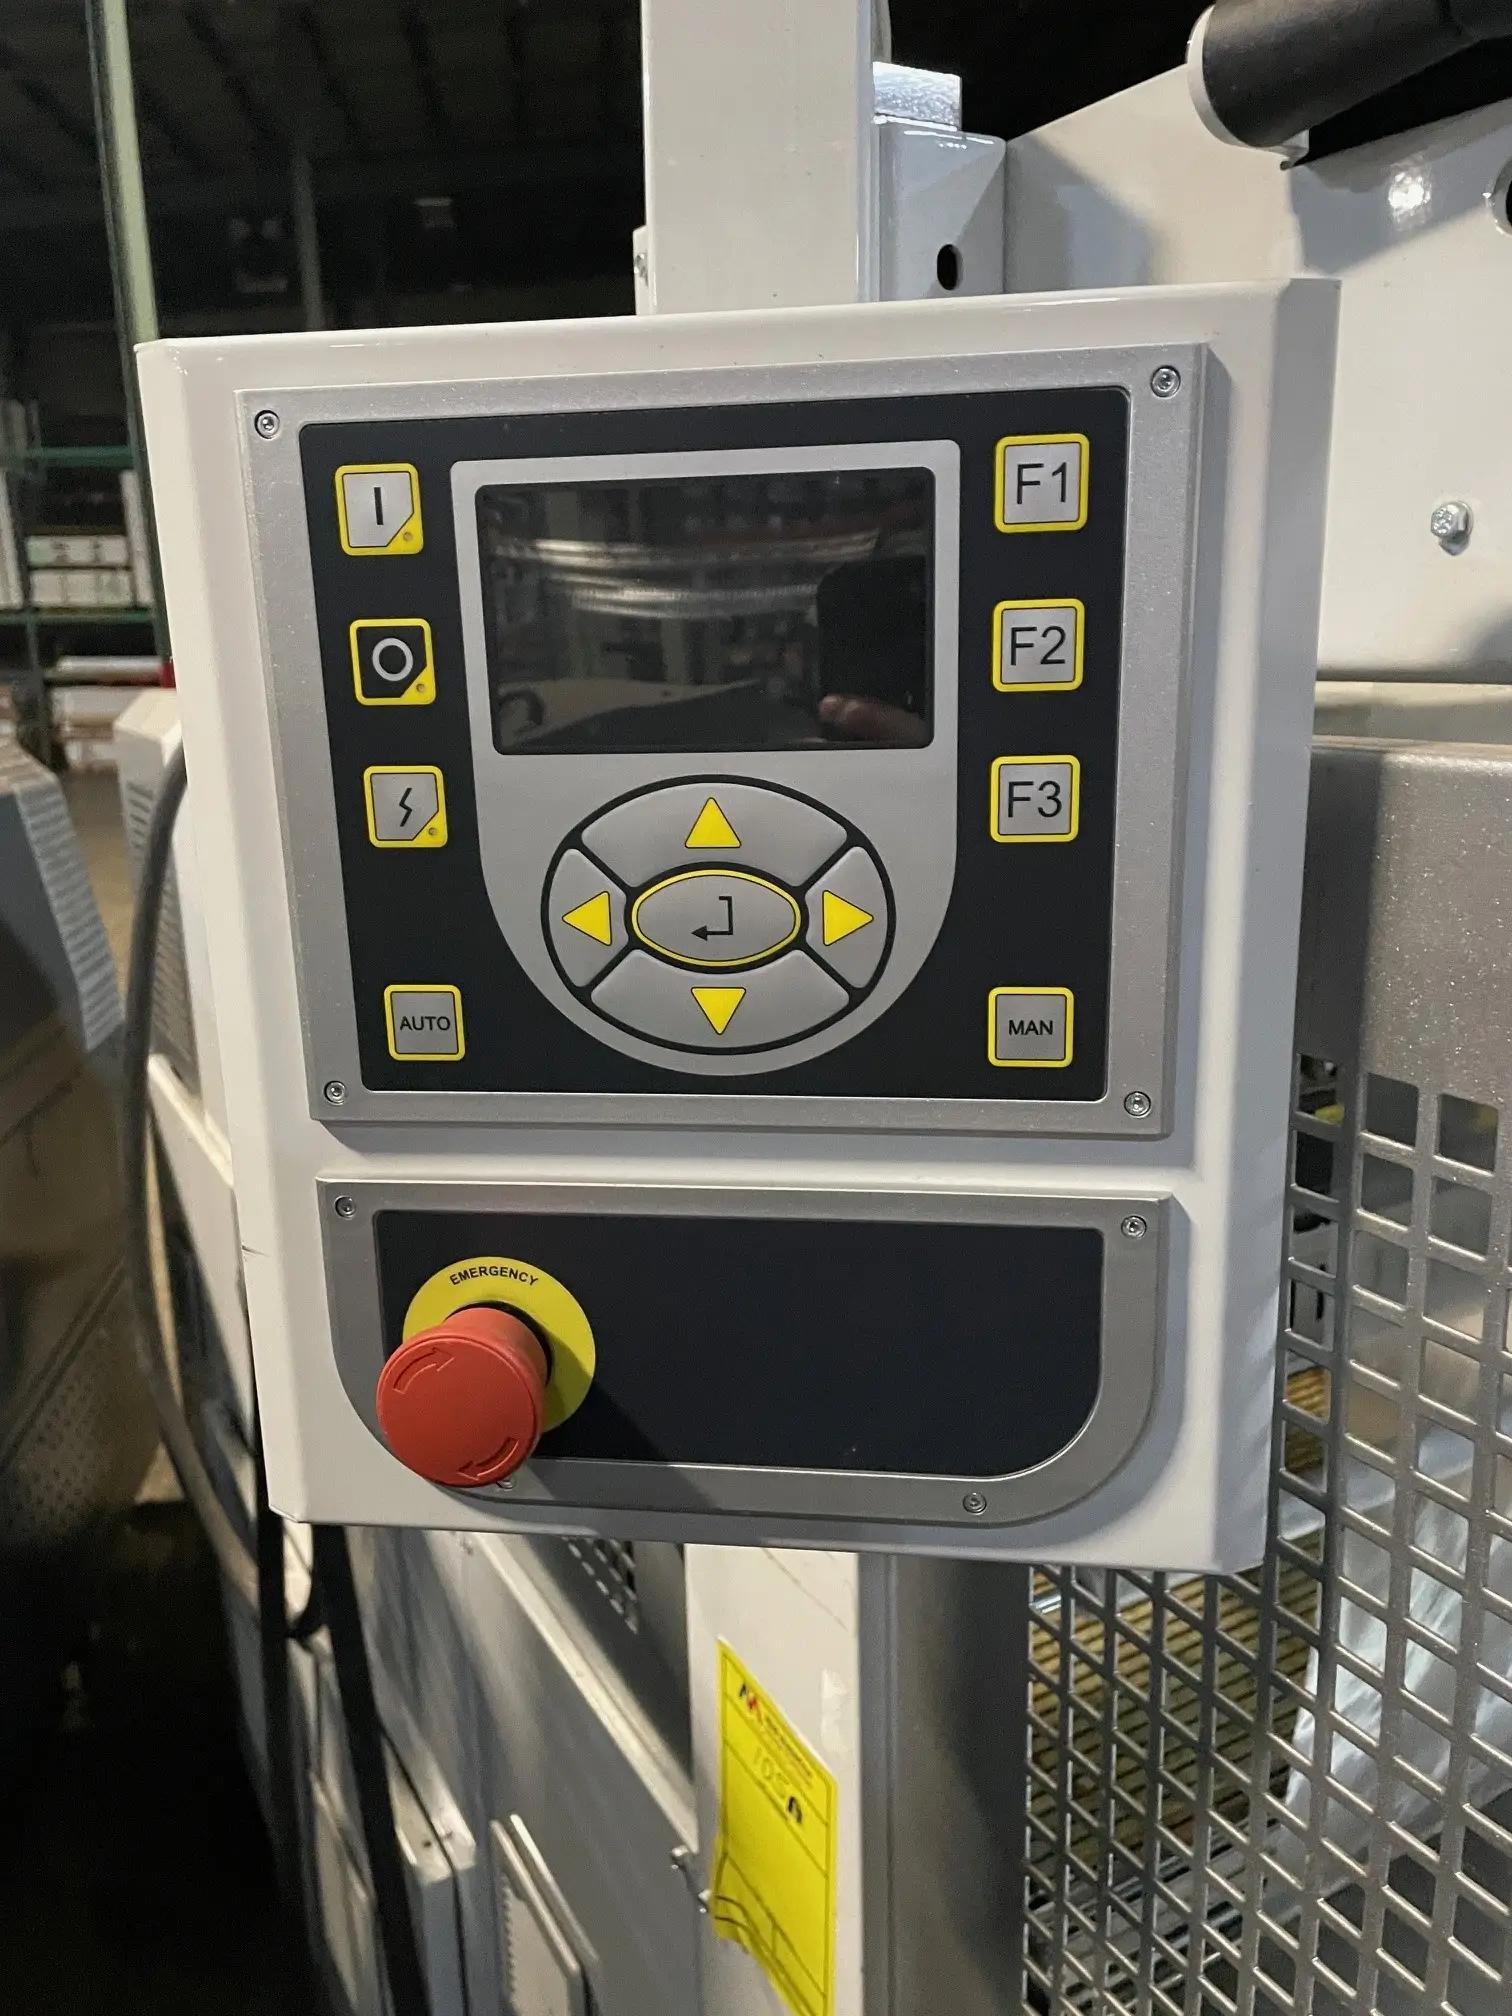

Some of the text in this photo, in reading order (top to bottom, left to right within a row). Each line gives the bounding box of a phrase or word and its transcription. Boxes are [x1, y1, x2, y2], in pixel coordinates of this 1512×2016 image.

[1015, 462, 1067, 505] F1
[1009, 625, 1067, 667] F2
[1007, 779, 1063, 819] F3
[399, 1015, 451, 1031] AUTO
[1008, 1019, 1054, 1036] MAN
[449, 1265, 539, 1286] EMERGENCY
